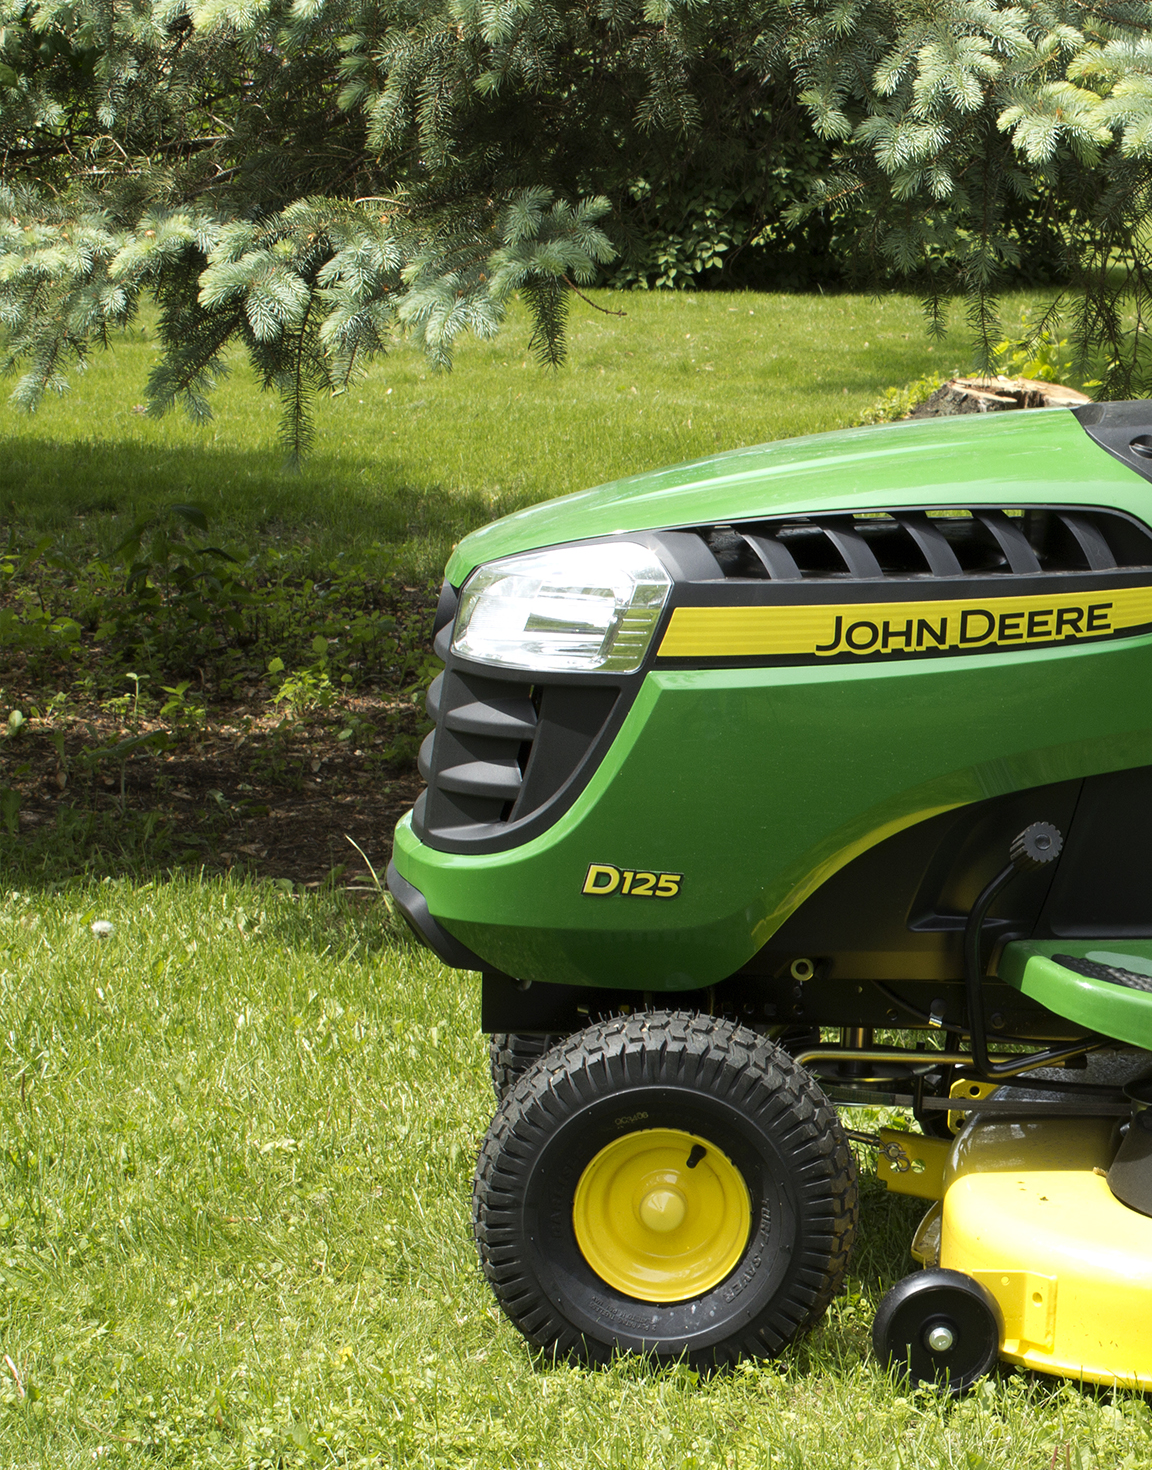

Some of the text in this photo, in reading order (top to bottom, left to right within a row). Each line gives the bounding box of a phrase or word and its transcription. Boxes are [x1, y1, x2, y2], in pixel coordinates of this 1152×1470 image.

[815, 602, 1114, 652] JOHN DEERE
[582, 863, 683, 898] D125
